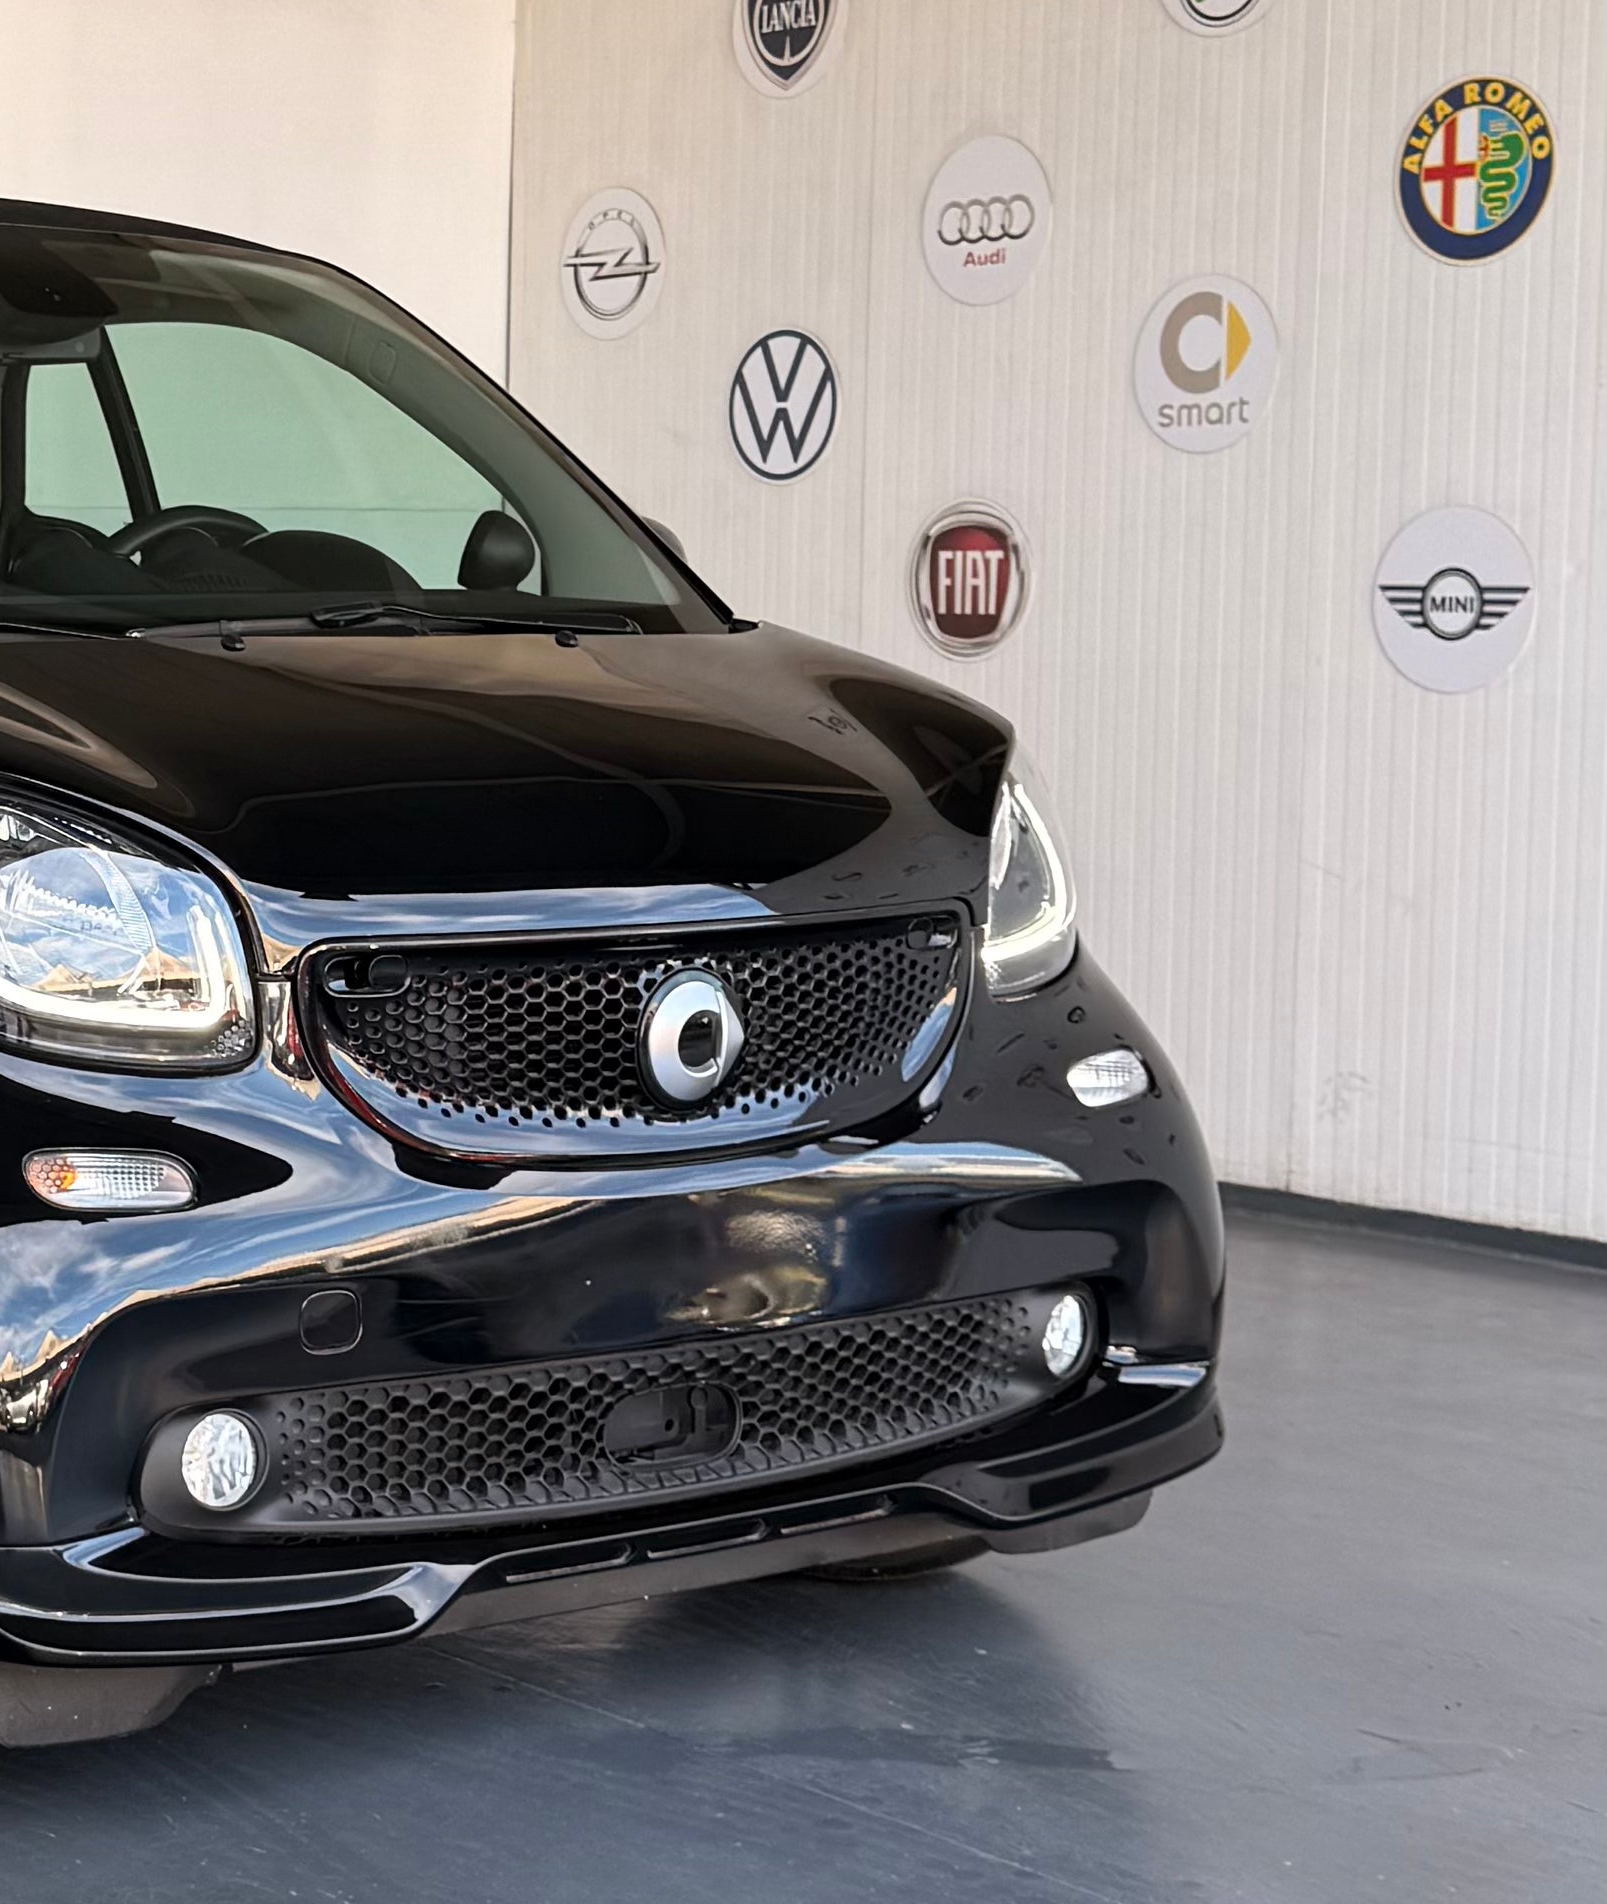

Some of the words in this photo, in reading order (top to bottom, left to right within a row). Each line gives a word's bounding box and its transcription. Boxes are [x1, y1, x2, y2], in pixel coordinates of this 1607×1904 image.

[1402, 99, 1453, 175] ALFA
[1463, 82, 1550, 159] ROMEO
[962, 247, 1006, 267] Audi
[1157, 396, 1250, 428] smart
[938, 550, 1004, 615] FIAT
[1429, 596, 1475, 614] MINI
